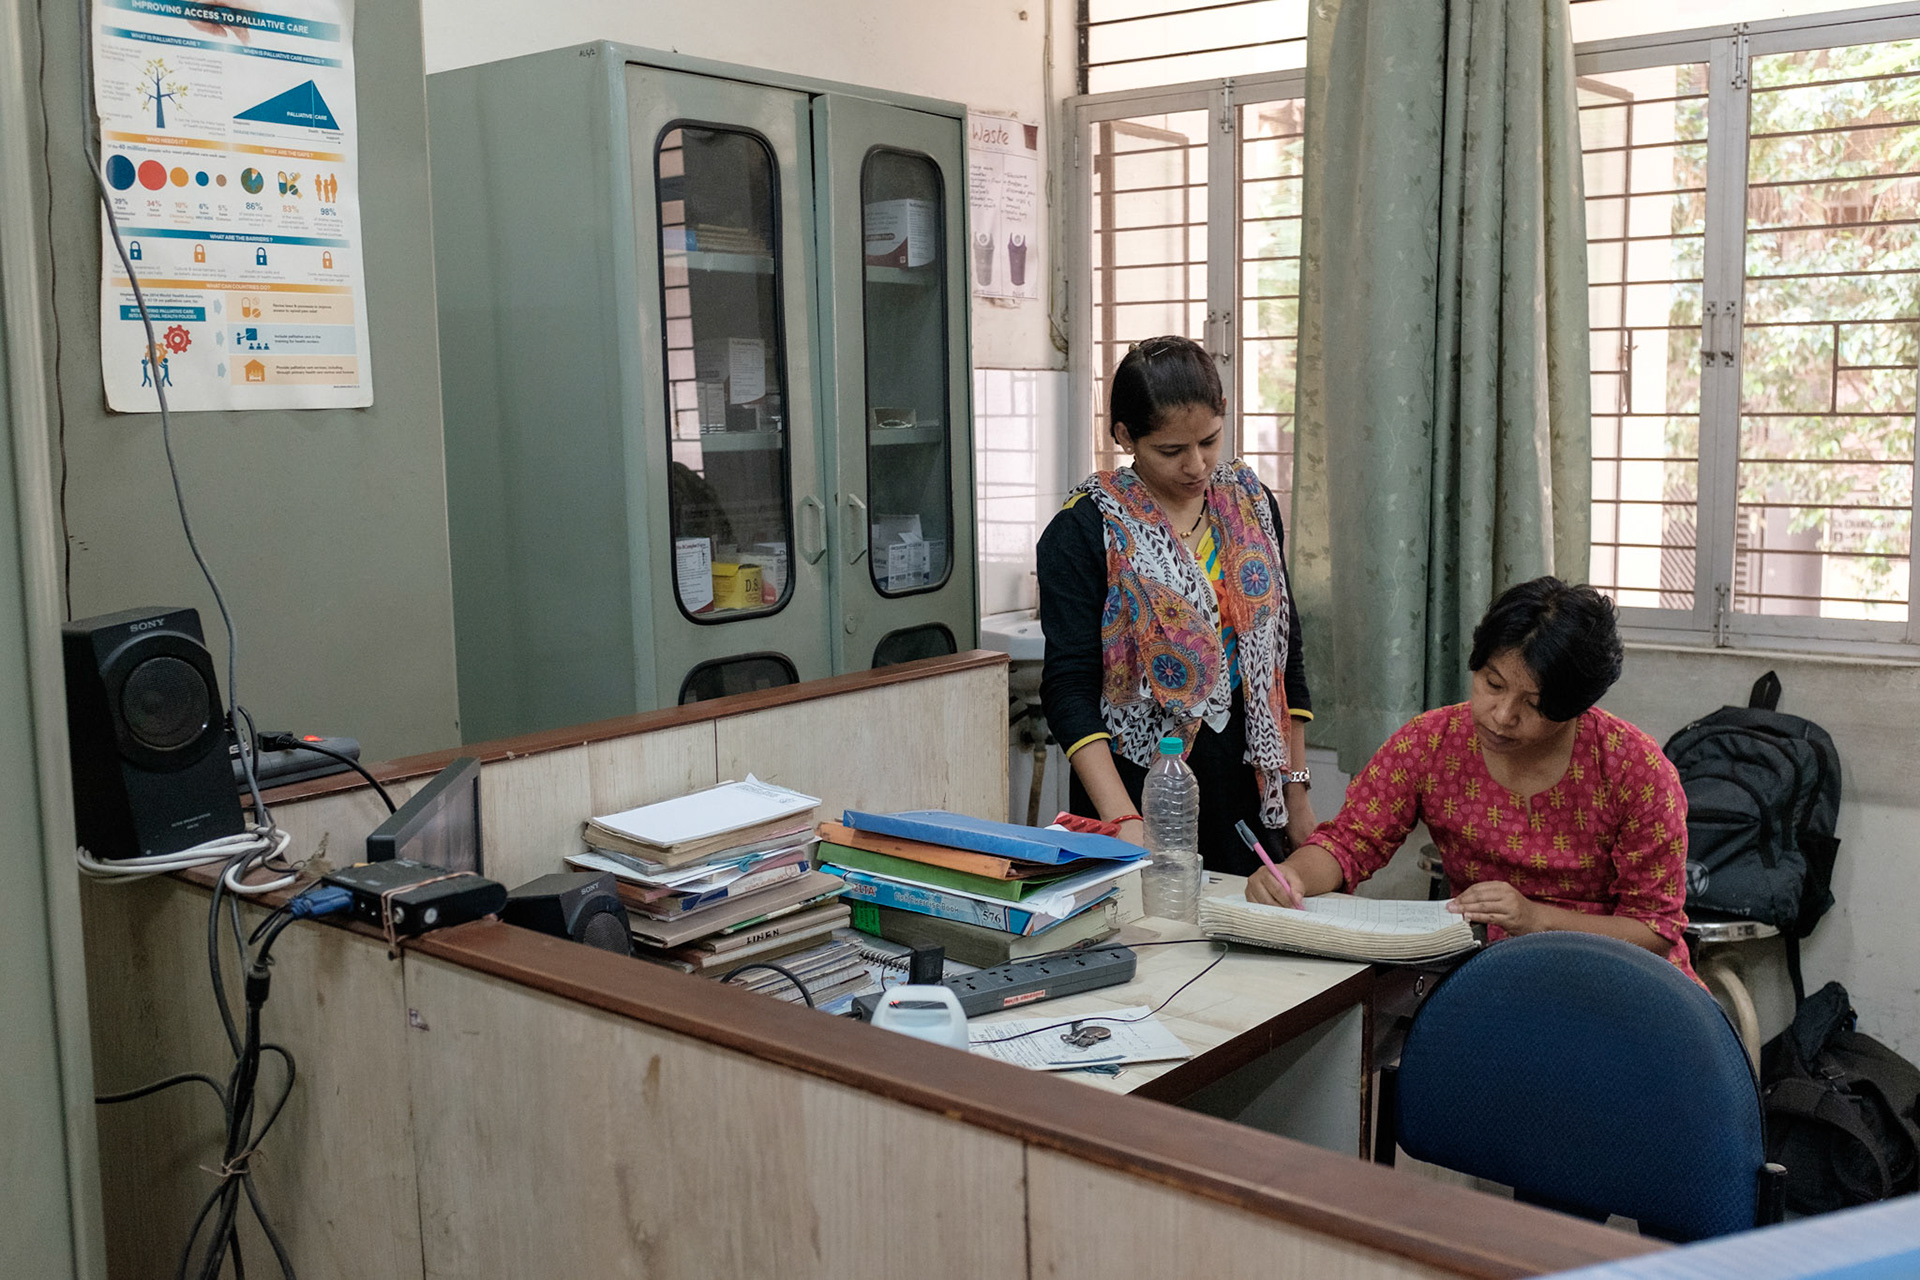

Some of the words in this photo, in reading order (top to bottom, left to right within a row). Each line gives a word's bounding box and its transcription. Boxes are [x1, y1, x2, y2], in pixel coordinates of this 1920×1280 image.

[131, 0, 182, 14] IMPROVING
[184, 8, 220, 20] ACCESS
[221, 12, 234, 22] TO
[236, 14, 285, 30] PALLIATIVE
[286, 23, 309, 34] CARE
[130, 32, 146, 40] WHAT
[152, 35, 182, 44] PALLIATIVE
[264, 51, 290, 60] PALLIATIVE
[286, 110, 313, 119] PALLIATIVE
[971, 122, 1009, 146] Waste
[246, 202, 263, 210] 86%
[282, 205, 299, 214] 83%
[320, 208, 336, 216] 98%
[130, 618, 166, 632] SONY
[580, 882, 599, 896] SONY
[852, 882, 877, 898] ELTA
[941, 902, 960, 913] Book
[982, 910, 1002, 924] 576
[746, 928, 780, 944] LINEN
